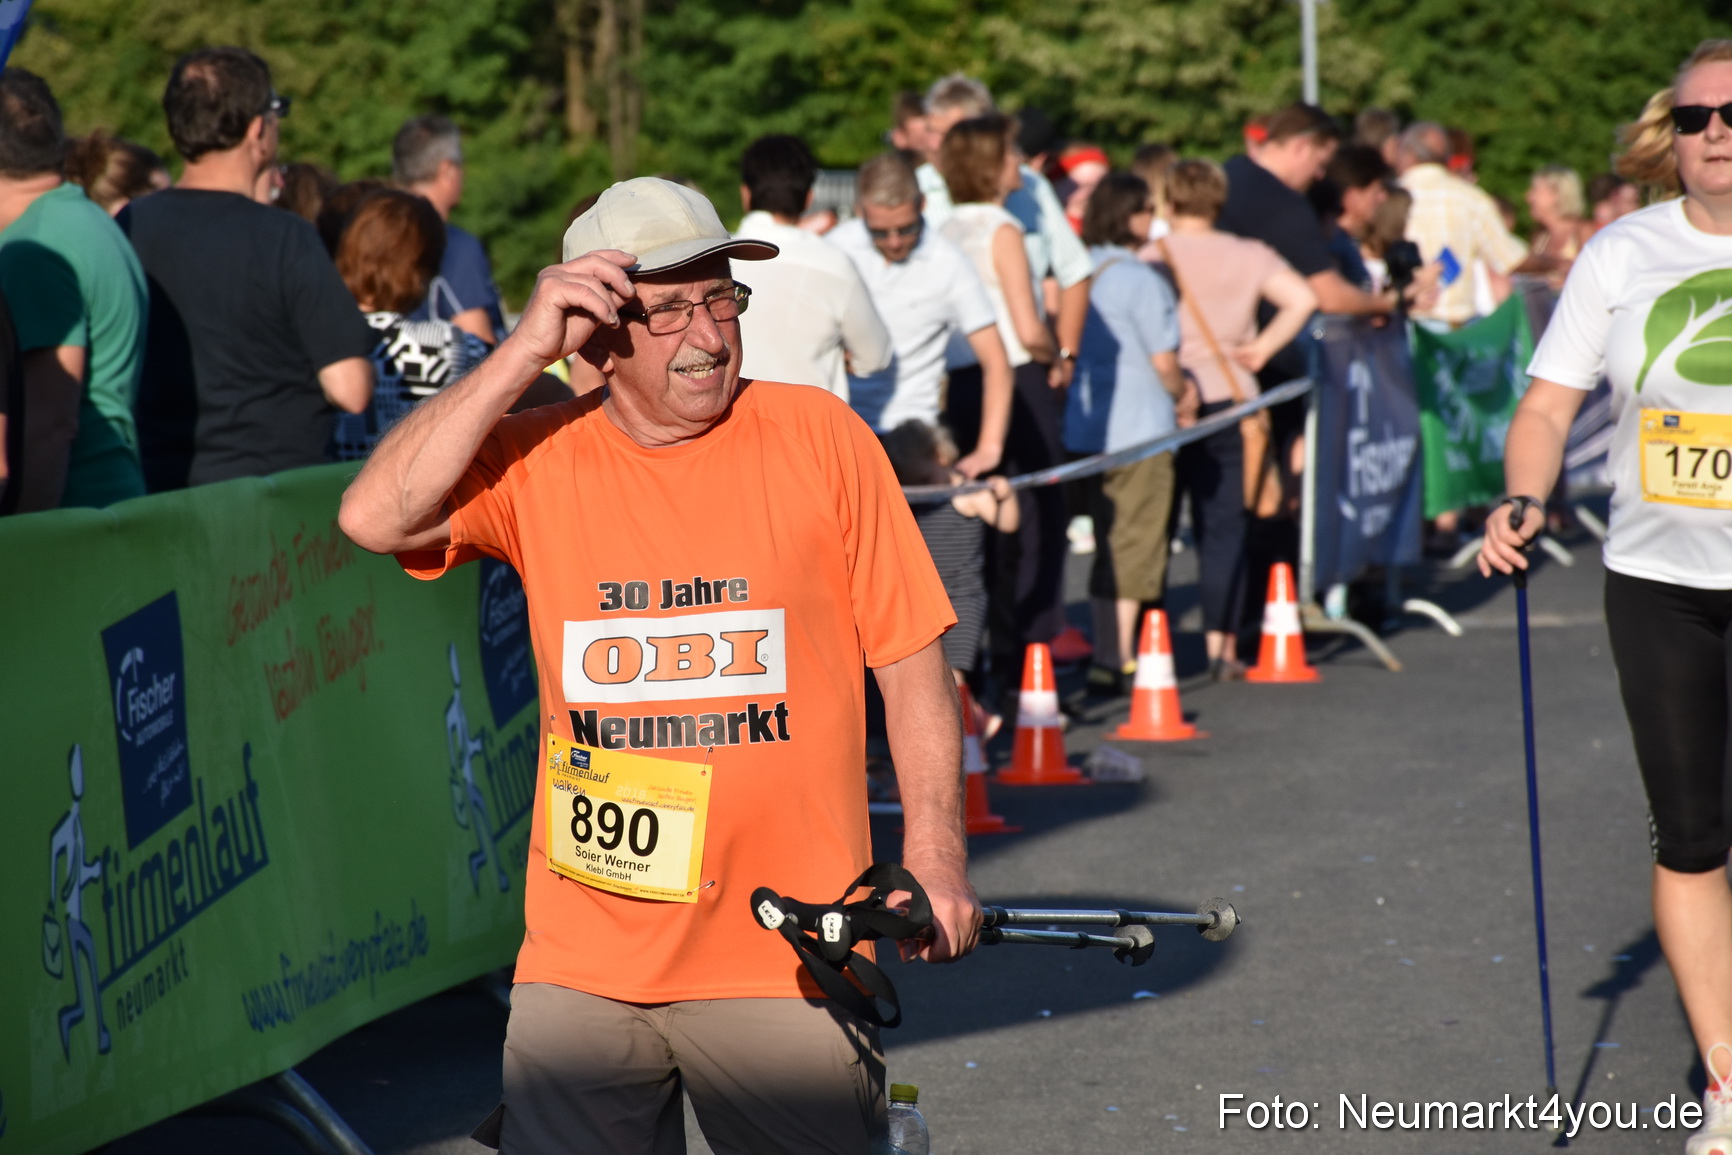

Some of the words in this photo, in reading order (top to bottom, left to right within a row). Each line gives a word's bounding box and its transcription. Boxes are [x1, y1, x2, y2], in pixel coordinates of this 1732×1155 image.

[598, 581, 649, 611] 30
[659, 576, 749, 610] Jahre
[582, 629, 768, 685] OBI
[126, 671, 177, 728] Fischer
[568, 701, 791, 750] Neumarkt
[561, 762, 611, 784] firmenlauf
[615, 785, 648, 801] 2018
[570, 795, 660, 857] 890
[100, 741, 270, 978] firmenlauf
[575, 845, 602, 863] Soier
[604, 854, 651, 873] Werner
[586, 863, 604, 876] Klebl
[606, 869, 632, 881] GmbH
[760, 904, 777, 923] LEKI
[115, 936, 191, 1033] neumarkt
